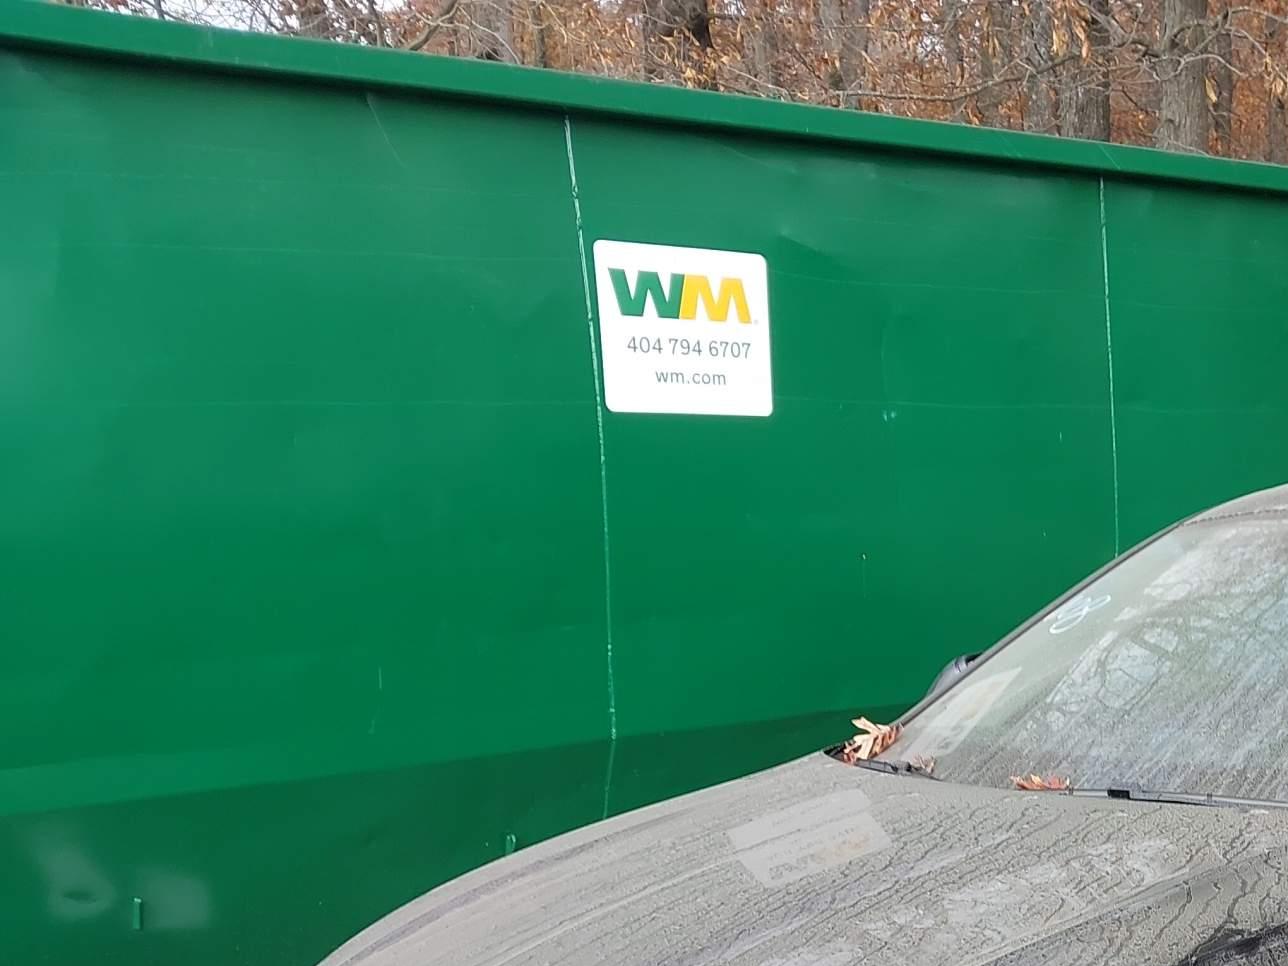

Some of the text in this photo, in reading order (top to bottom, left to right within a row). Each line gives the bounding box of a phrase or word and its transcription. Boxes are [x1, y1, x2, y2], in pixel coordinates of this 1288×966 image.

[607, 267, 752, 324] WM
[626, 336, 751, 359] 404 794 6707
[655, 371, 727, 386] wm.com
